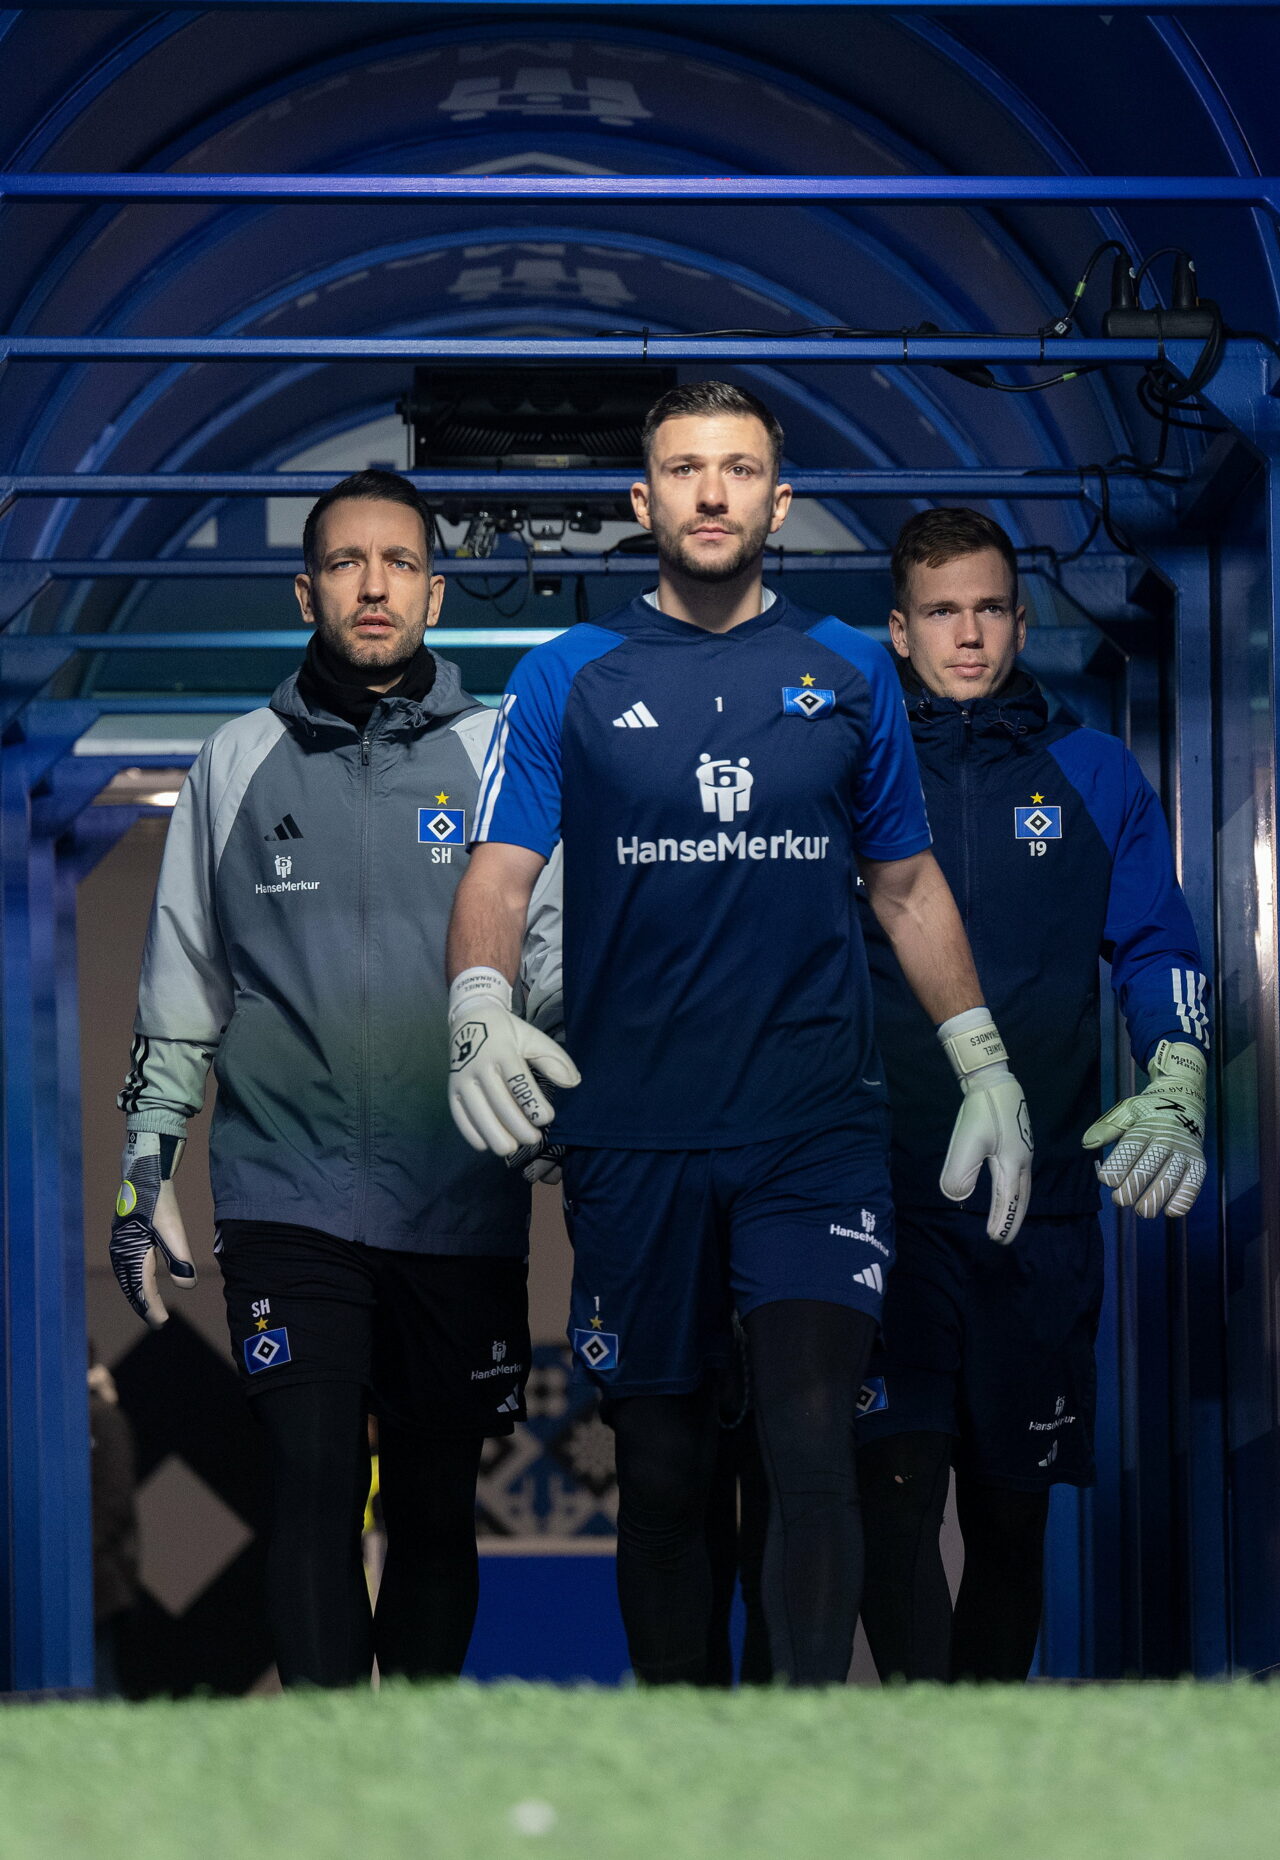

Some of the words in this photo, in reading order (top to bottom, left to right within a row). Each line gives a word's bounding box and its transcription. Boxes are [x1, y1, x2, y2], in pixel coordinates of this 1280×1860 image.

[714, 696, 723, 712] 1
[617, 829, 829, 865] HanseMerkur
[1028, 840, 1047, 857] 19
[431, 848, 452, 864] SH
[255, 881, 320, 894] HanseMerkur
[251, 1298, 271, 1318] SH
[593, 1296, 600, 1311] 1
